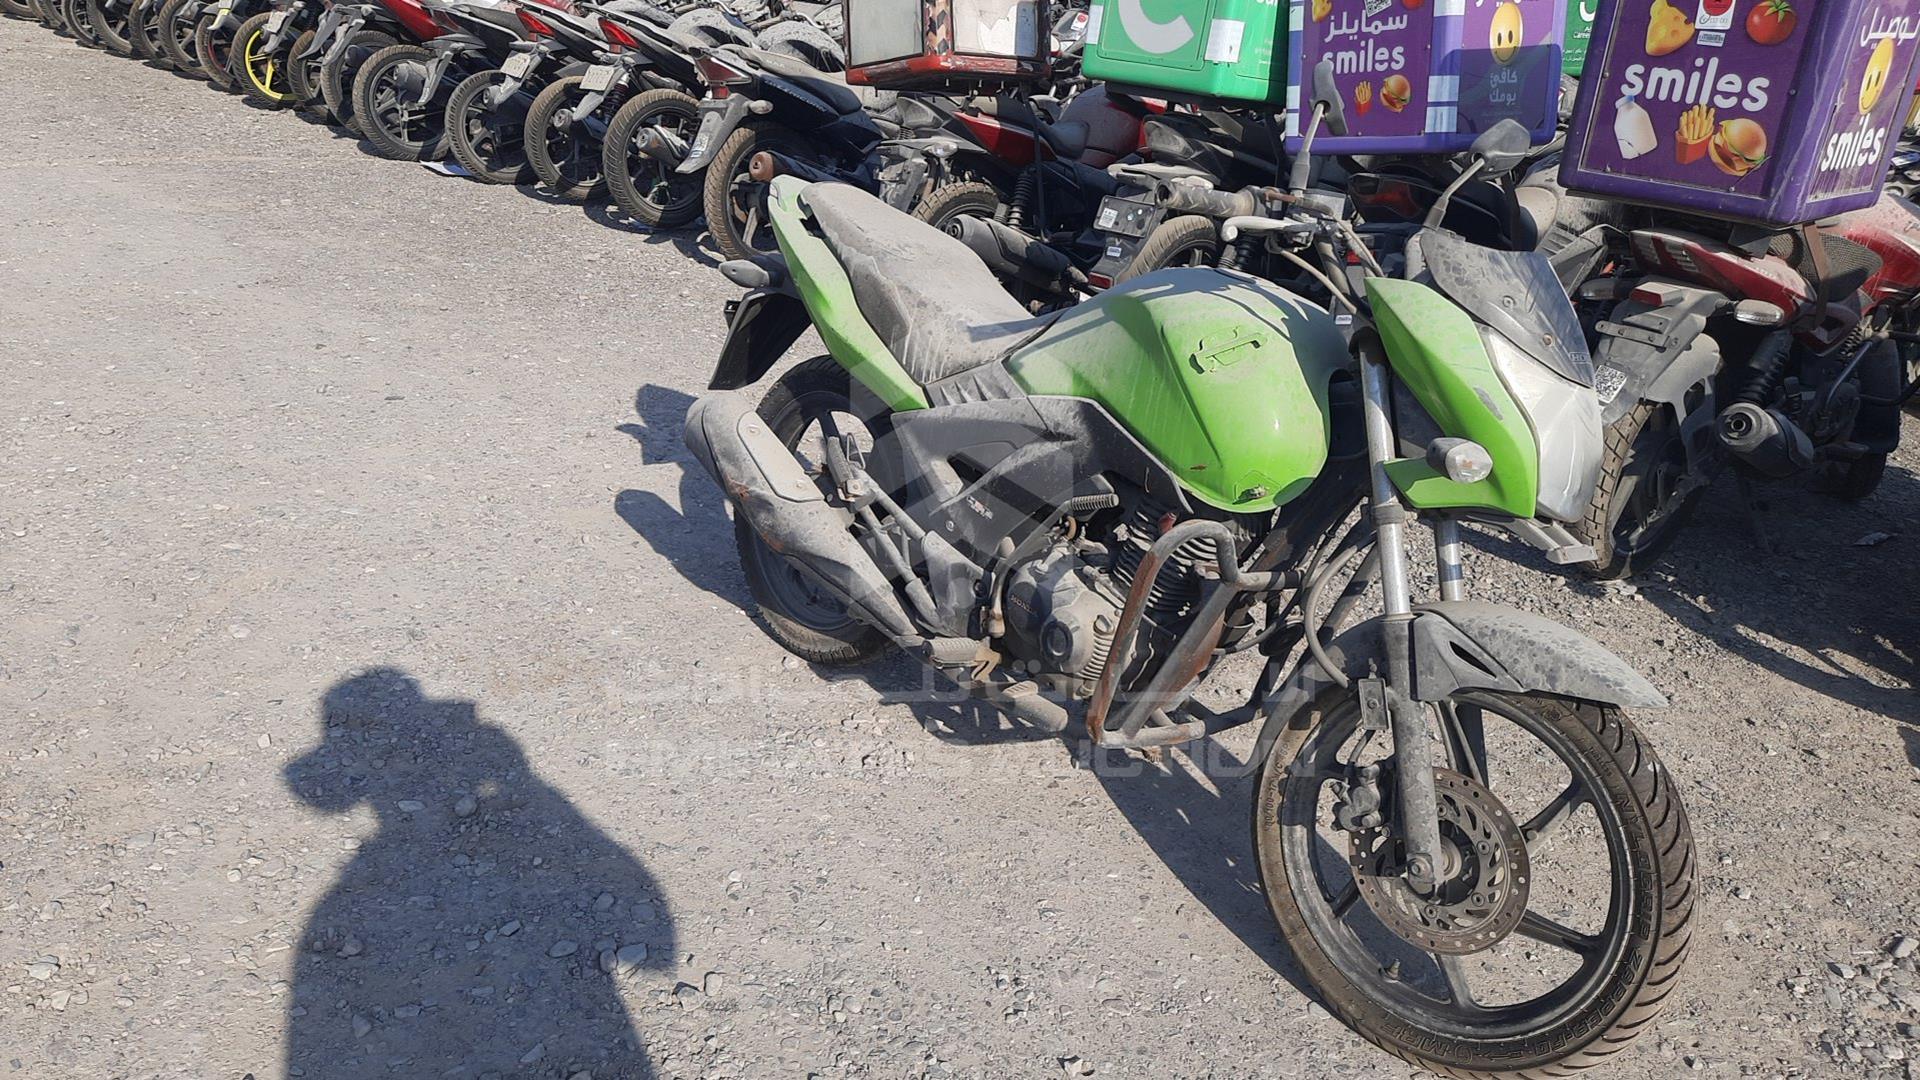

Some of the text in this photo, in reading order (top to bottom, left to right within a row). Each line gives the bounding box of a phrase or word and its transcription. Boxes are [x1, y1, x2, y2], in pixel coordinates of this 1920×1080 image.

[1324, 11, 1408, 43] سمايلز
[1322, 38, 1406, 75] smiles
[1620, 56, 1770, 112] smiles
[1821, 113, 1885, 172] smiles
